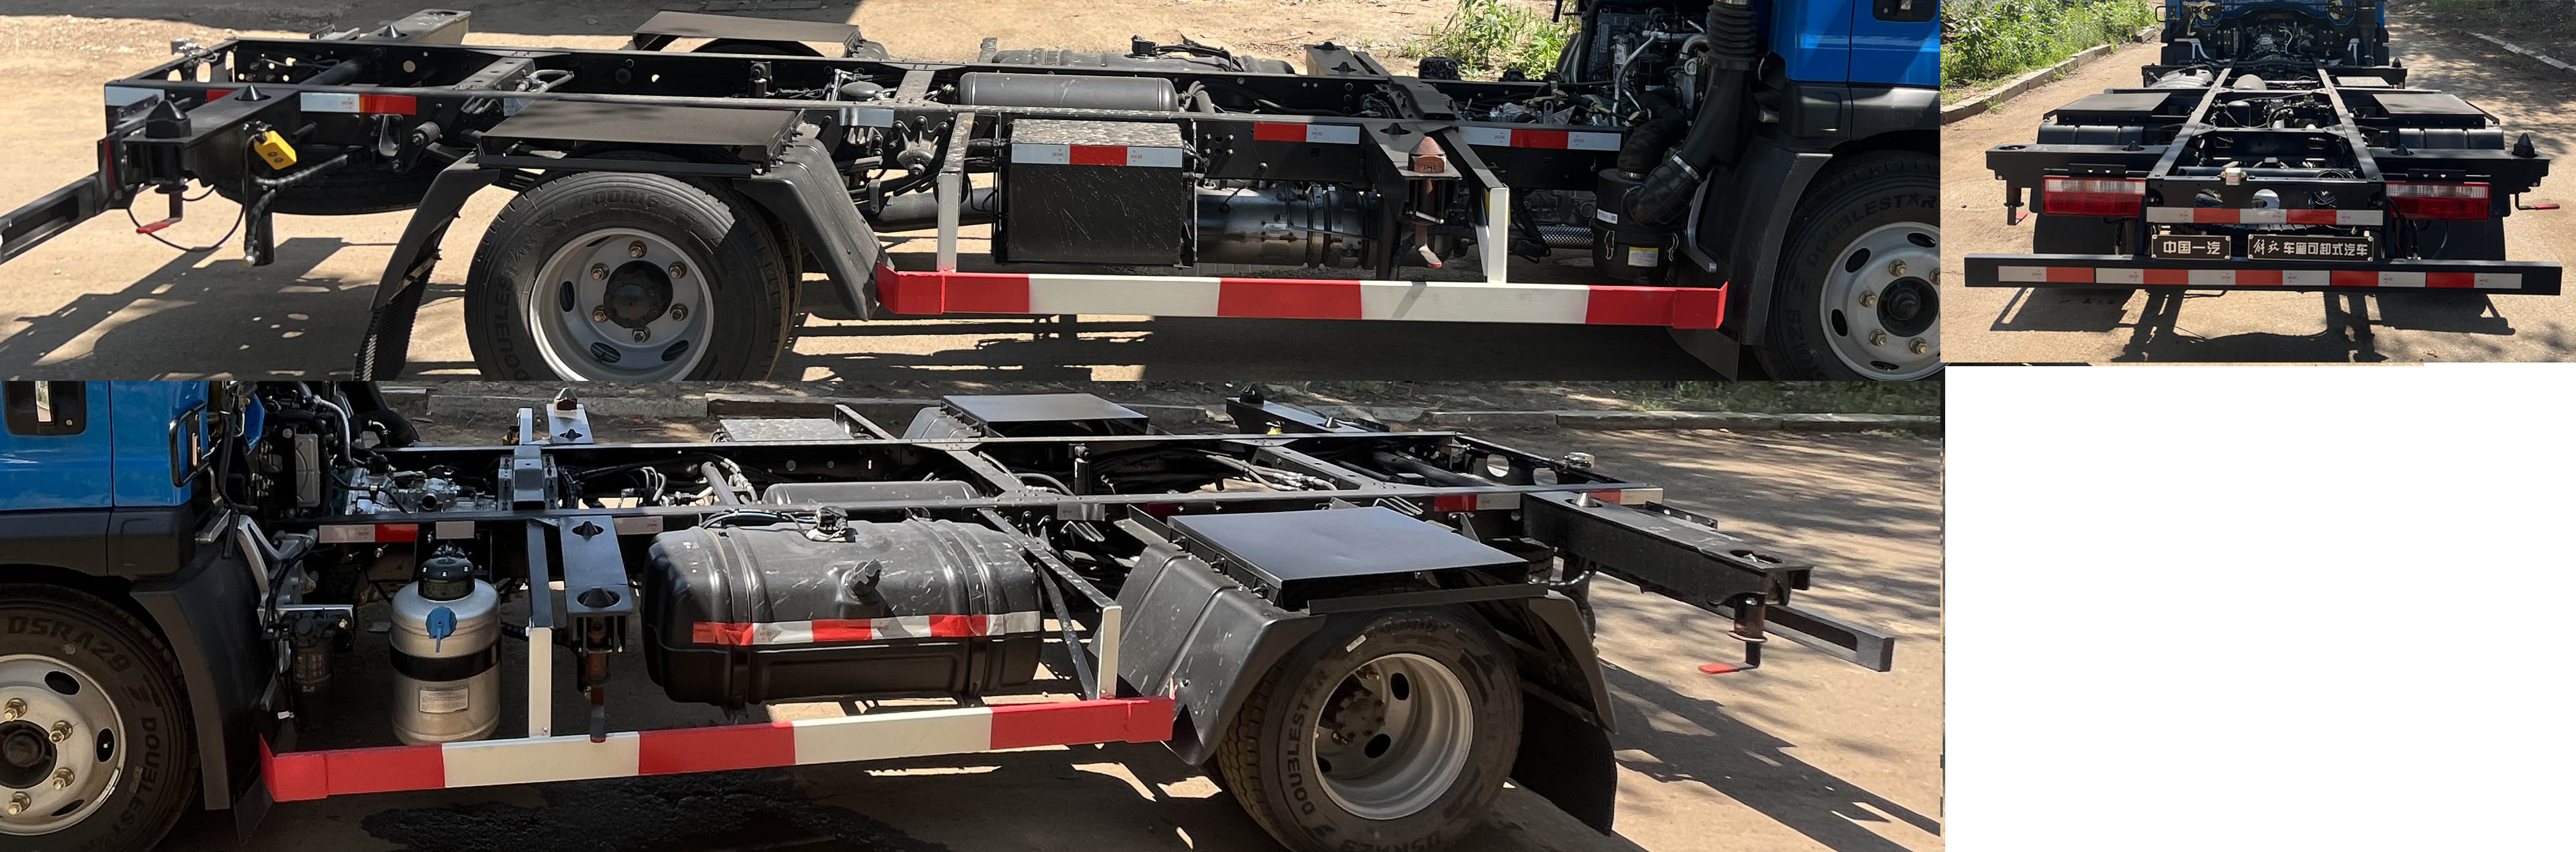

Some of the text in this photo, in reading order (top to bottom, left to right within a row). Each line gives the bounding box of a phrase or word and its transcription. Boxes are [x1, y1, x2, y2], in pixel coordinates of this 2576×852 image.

[2163, 240, 2220, 255] 中国一汽
[2253, 239, 2368, 256] 解放 车厢可卸式汽车
[7, 615, 132, 673] DSRA29
